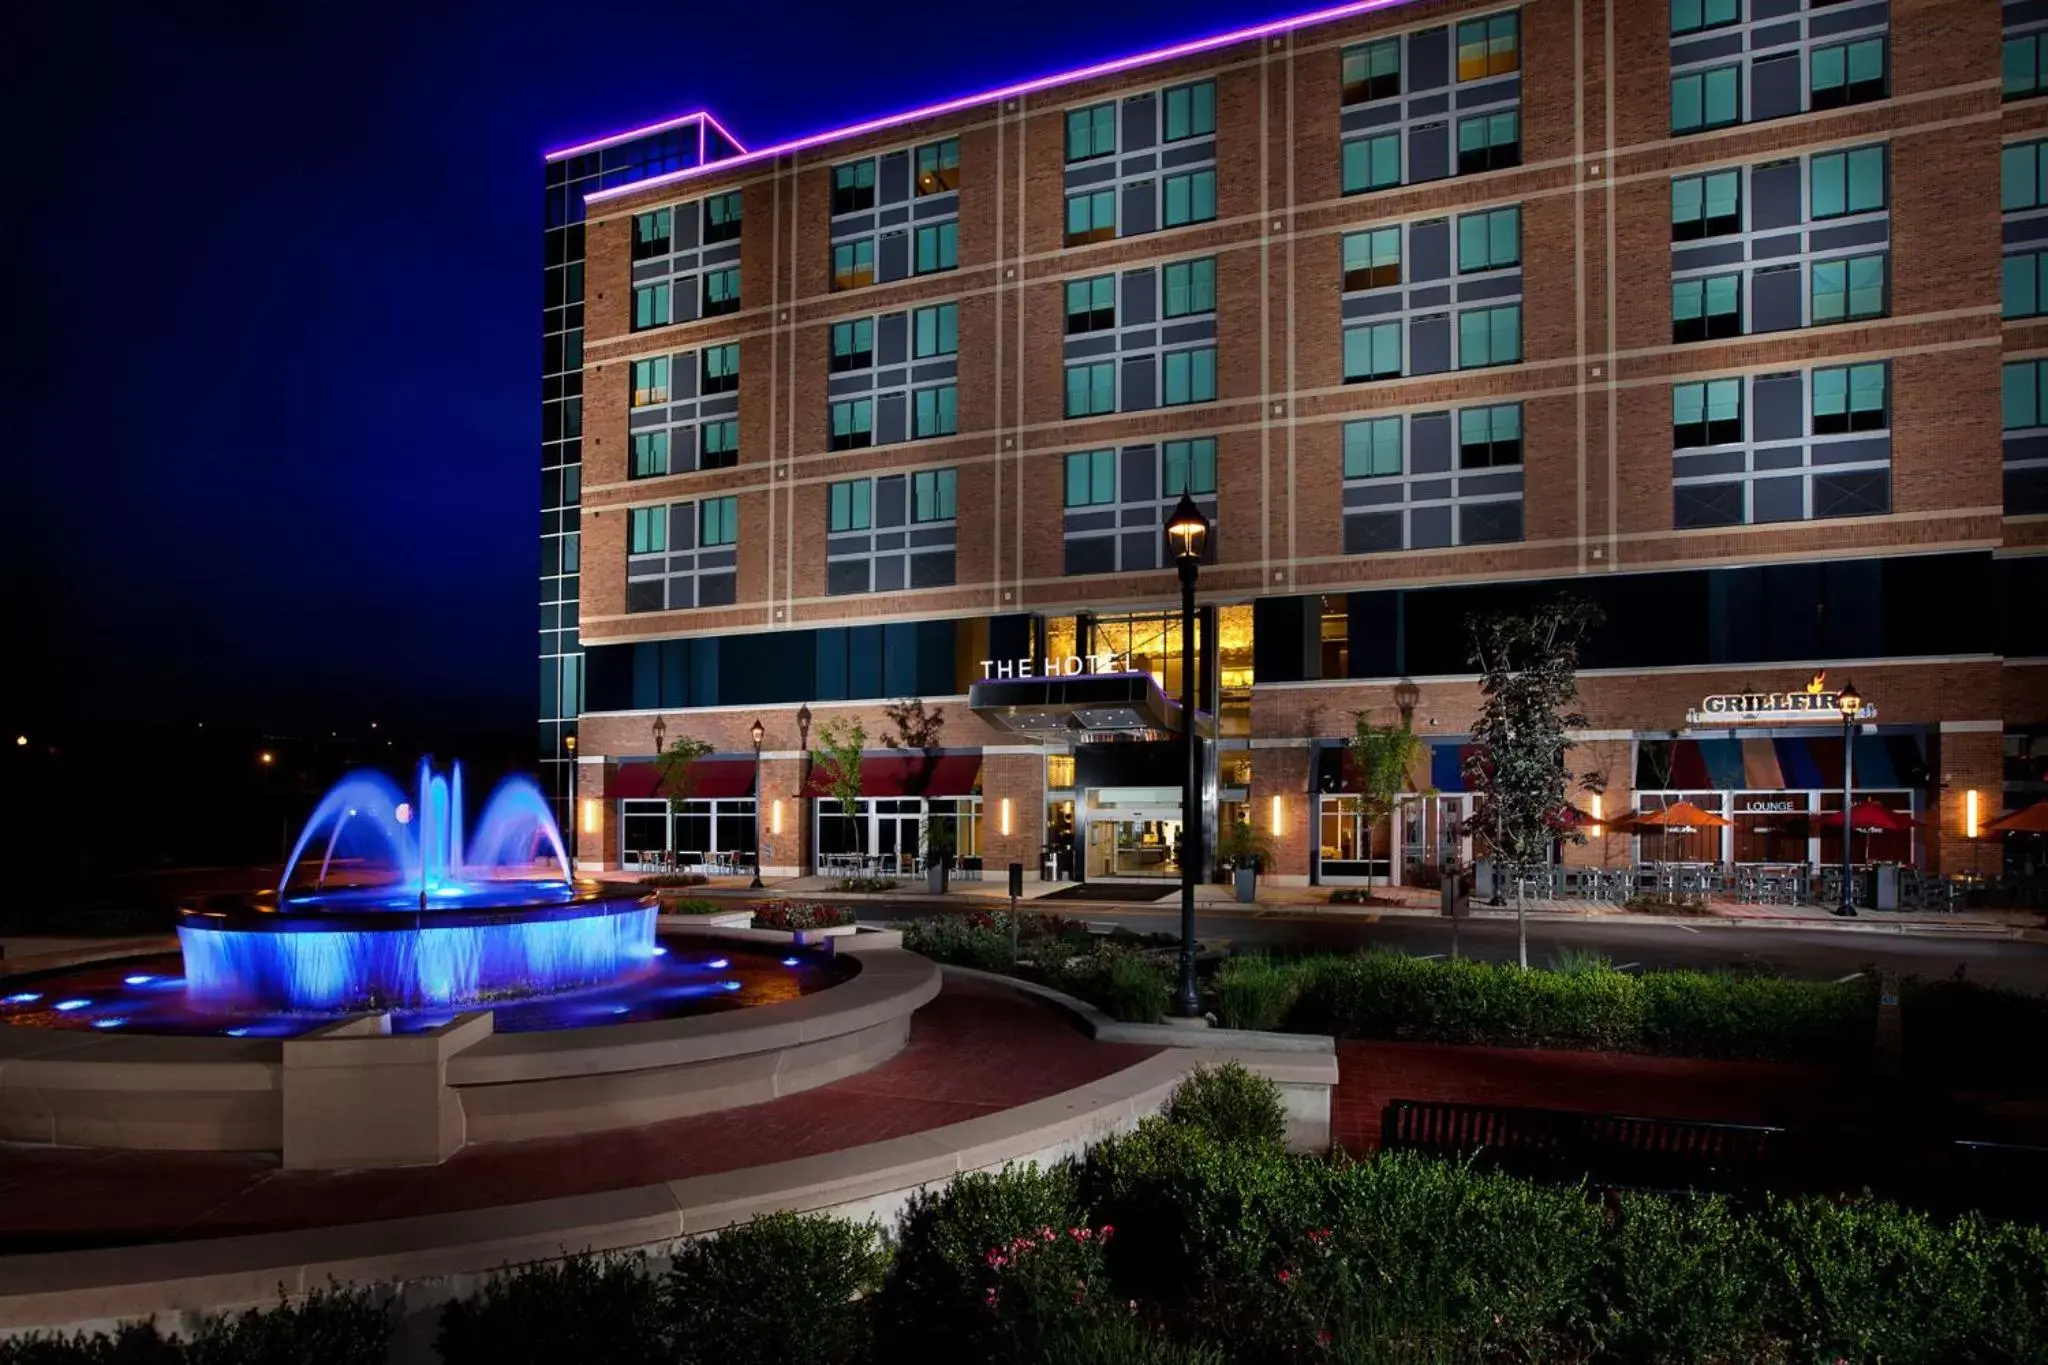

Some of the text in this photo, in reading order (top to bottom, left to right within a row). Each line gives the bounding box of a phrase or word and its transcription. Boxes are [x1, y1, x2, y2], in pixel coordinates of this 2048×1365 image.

[980, 653, 1139, 681] THE HOTEL
[1704, 692, 1848, 713] GRILLFIR
[1747, 801, 1795, 811] LOUNGE
